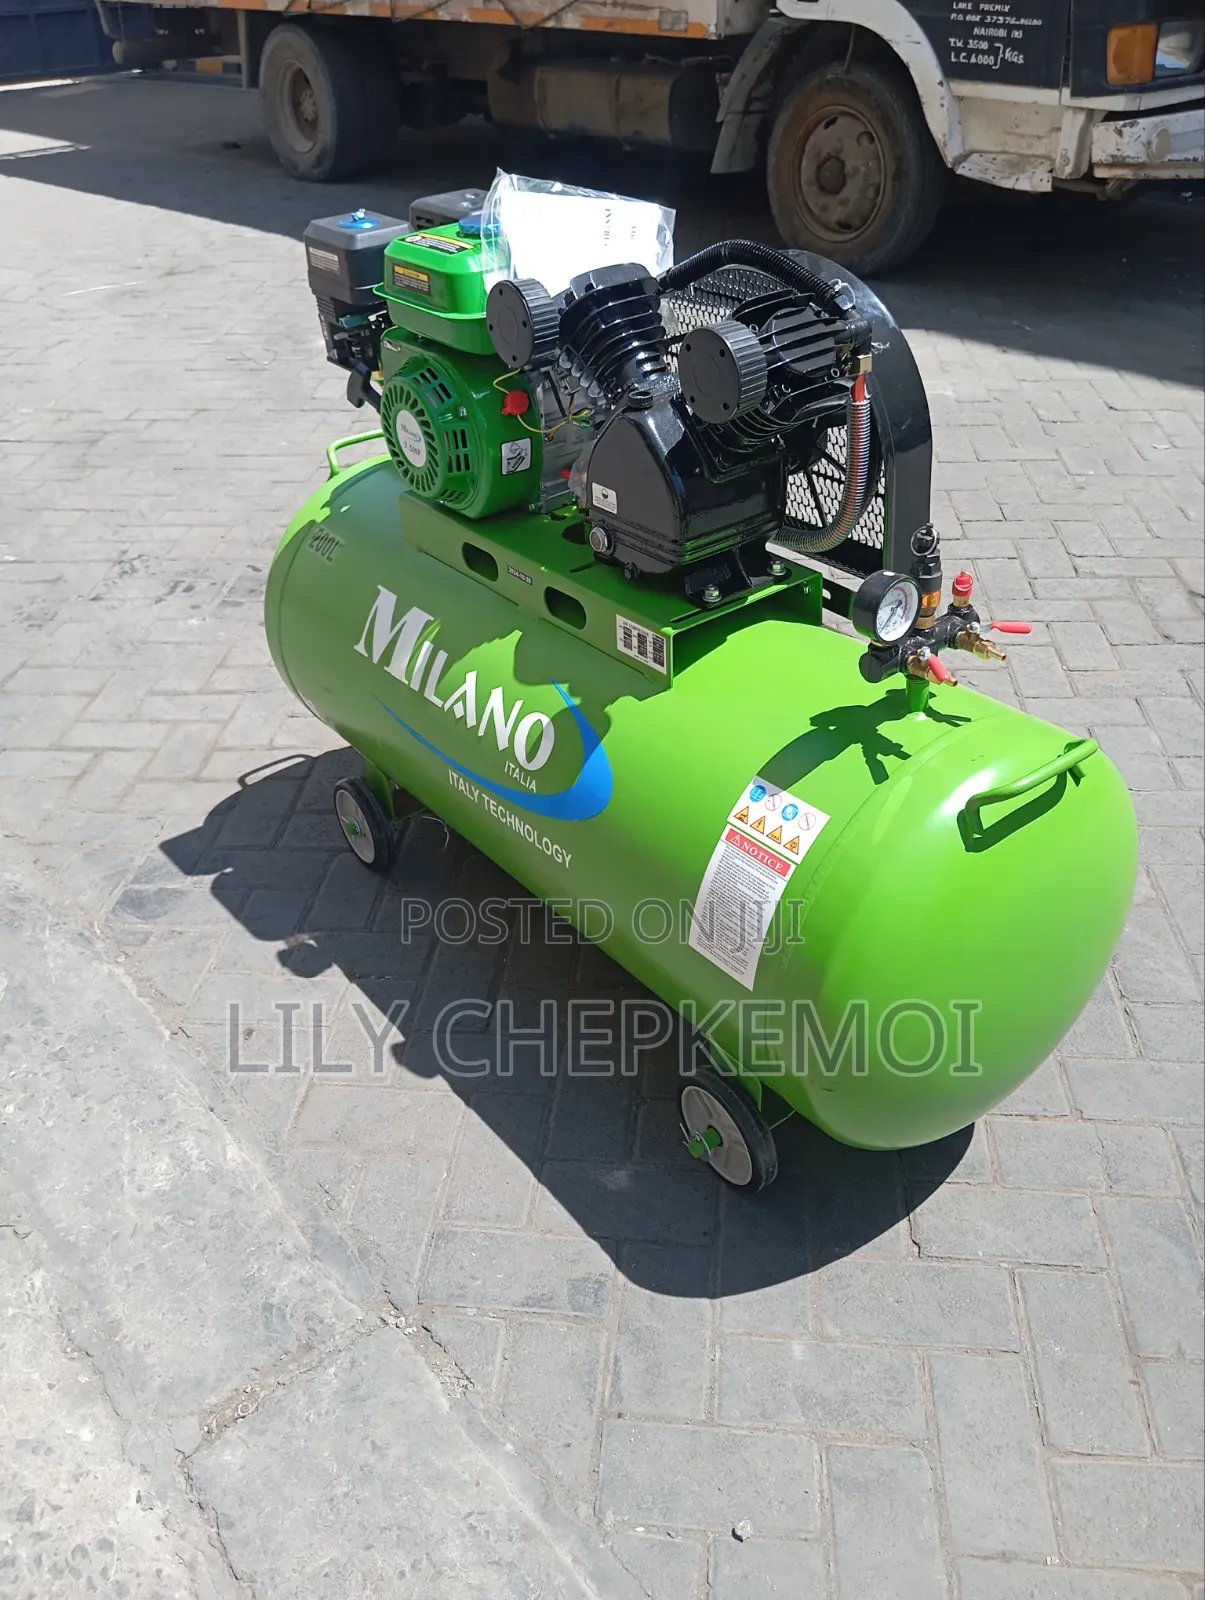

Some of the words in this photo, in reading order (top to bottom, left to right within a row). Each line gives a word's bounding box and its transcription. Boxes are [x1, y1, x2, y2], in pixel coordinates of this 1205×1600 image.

[953, 2, 973, 10] LAKE
[979, 3, 1011, 12] PREMIX
[965, 14, 982, 22] BOX
[973, 27, 1008, 38] NAIROBI
[966, 39, 989, 50] 3500
[404, 441, 421, 456] 7.5HP
[308, 527, 340, 563] 200L
[354, 584, 555, 771] MILANO
[504, 760, 537, 793] ITALIA
[448, 769, 479, 803] ITALY
[482, 793, 572, 869] TECHNOLOGY
[741, 842, 784, 872] NOTICE
